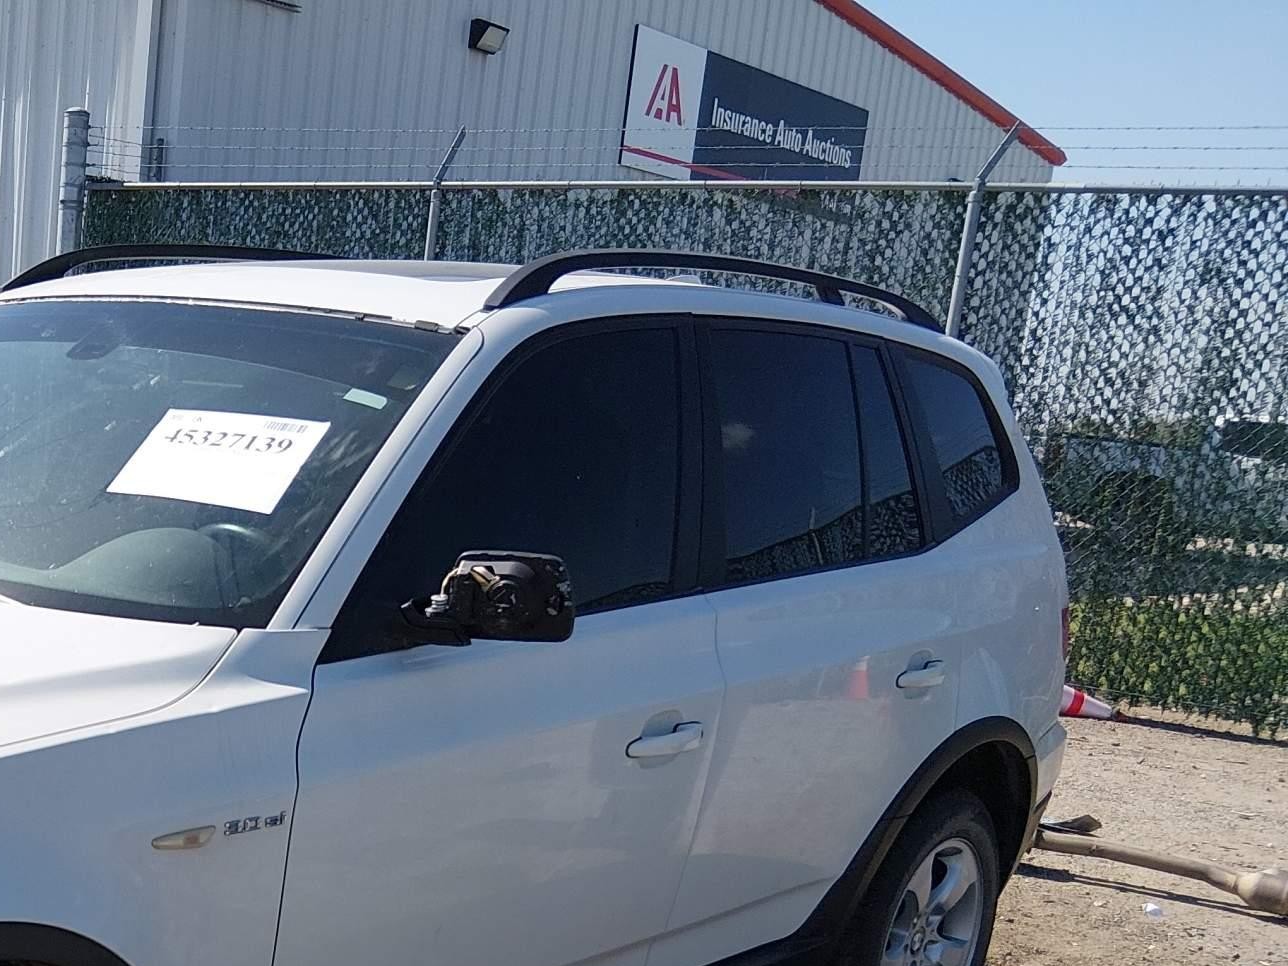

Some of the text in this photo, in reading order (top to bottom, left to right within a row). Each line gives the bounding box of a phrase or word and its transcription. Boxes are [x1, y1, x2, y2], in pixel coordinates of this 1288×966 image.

[711, 97, 852, 169] Insurance Auto Auctions
[164, 427, 294, 454] 45327139
